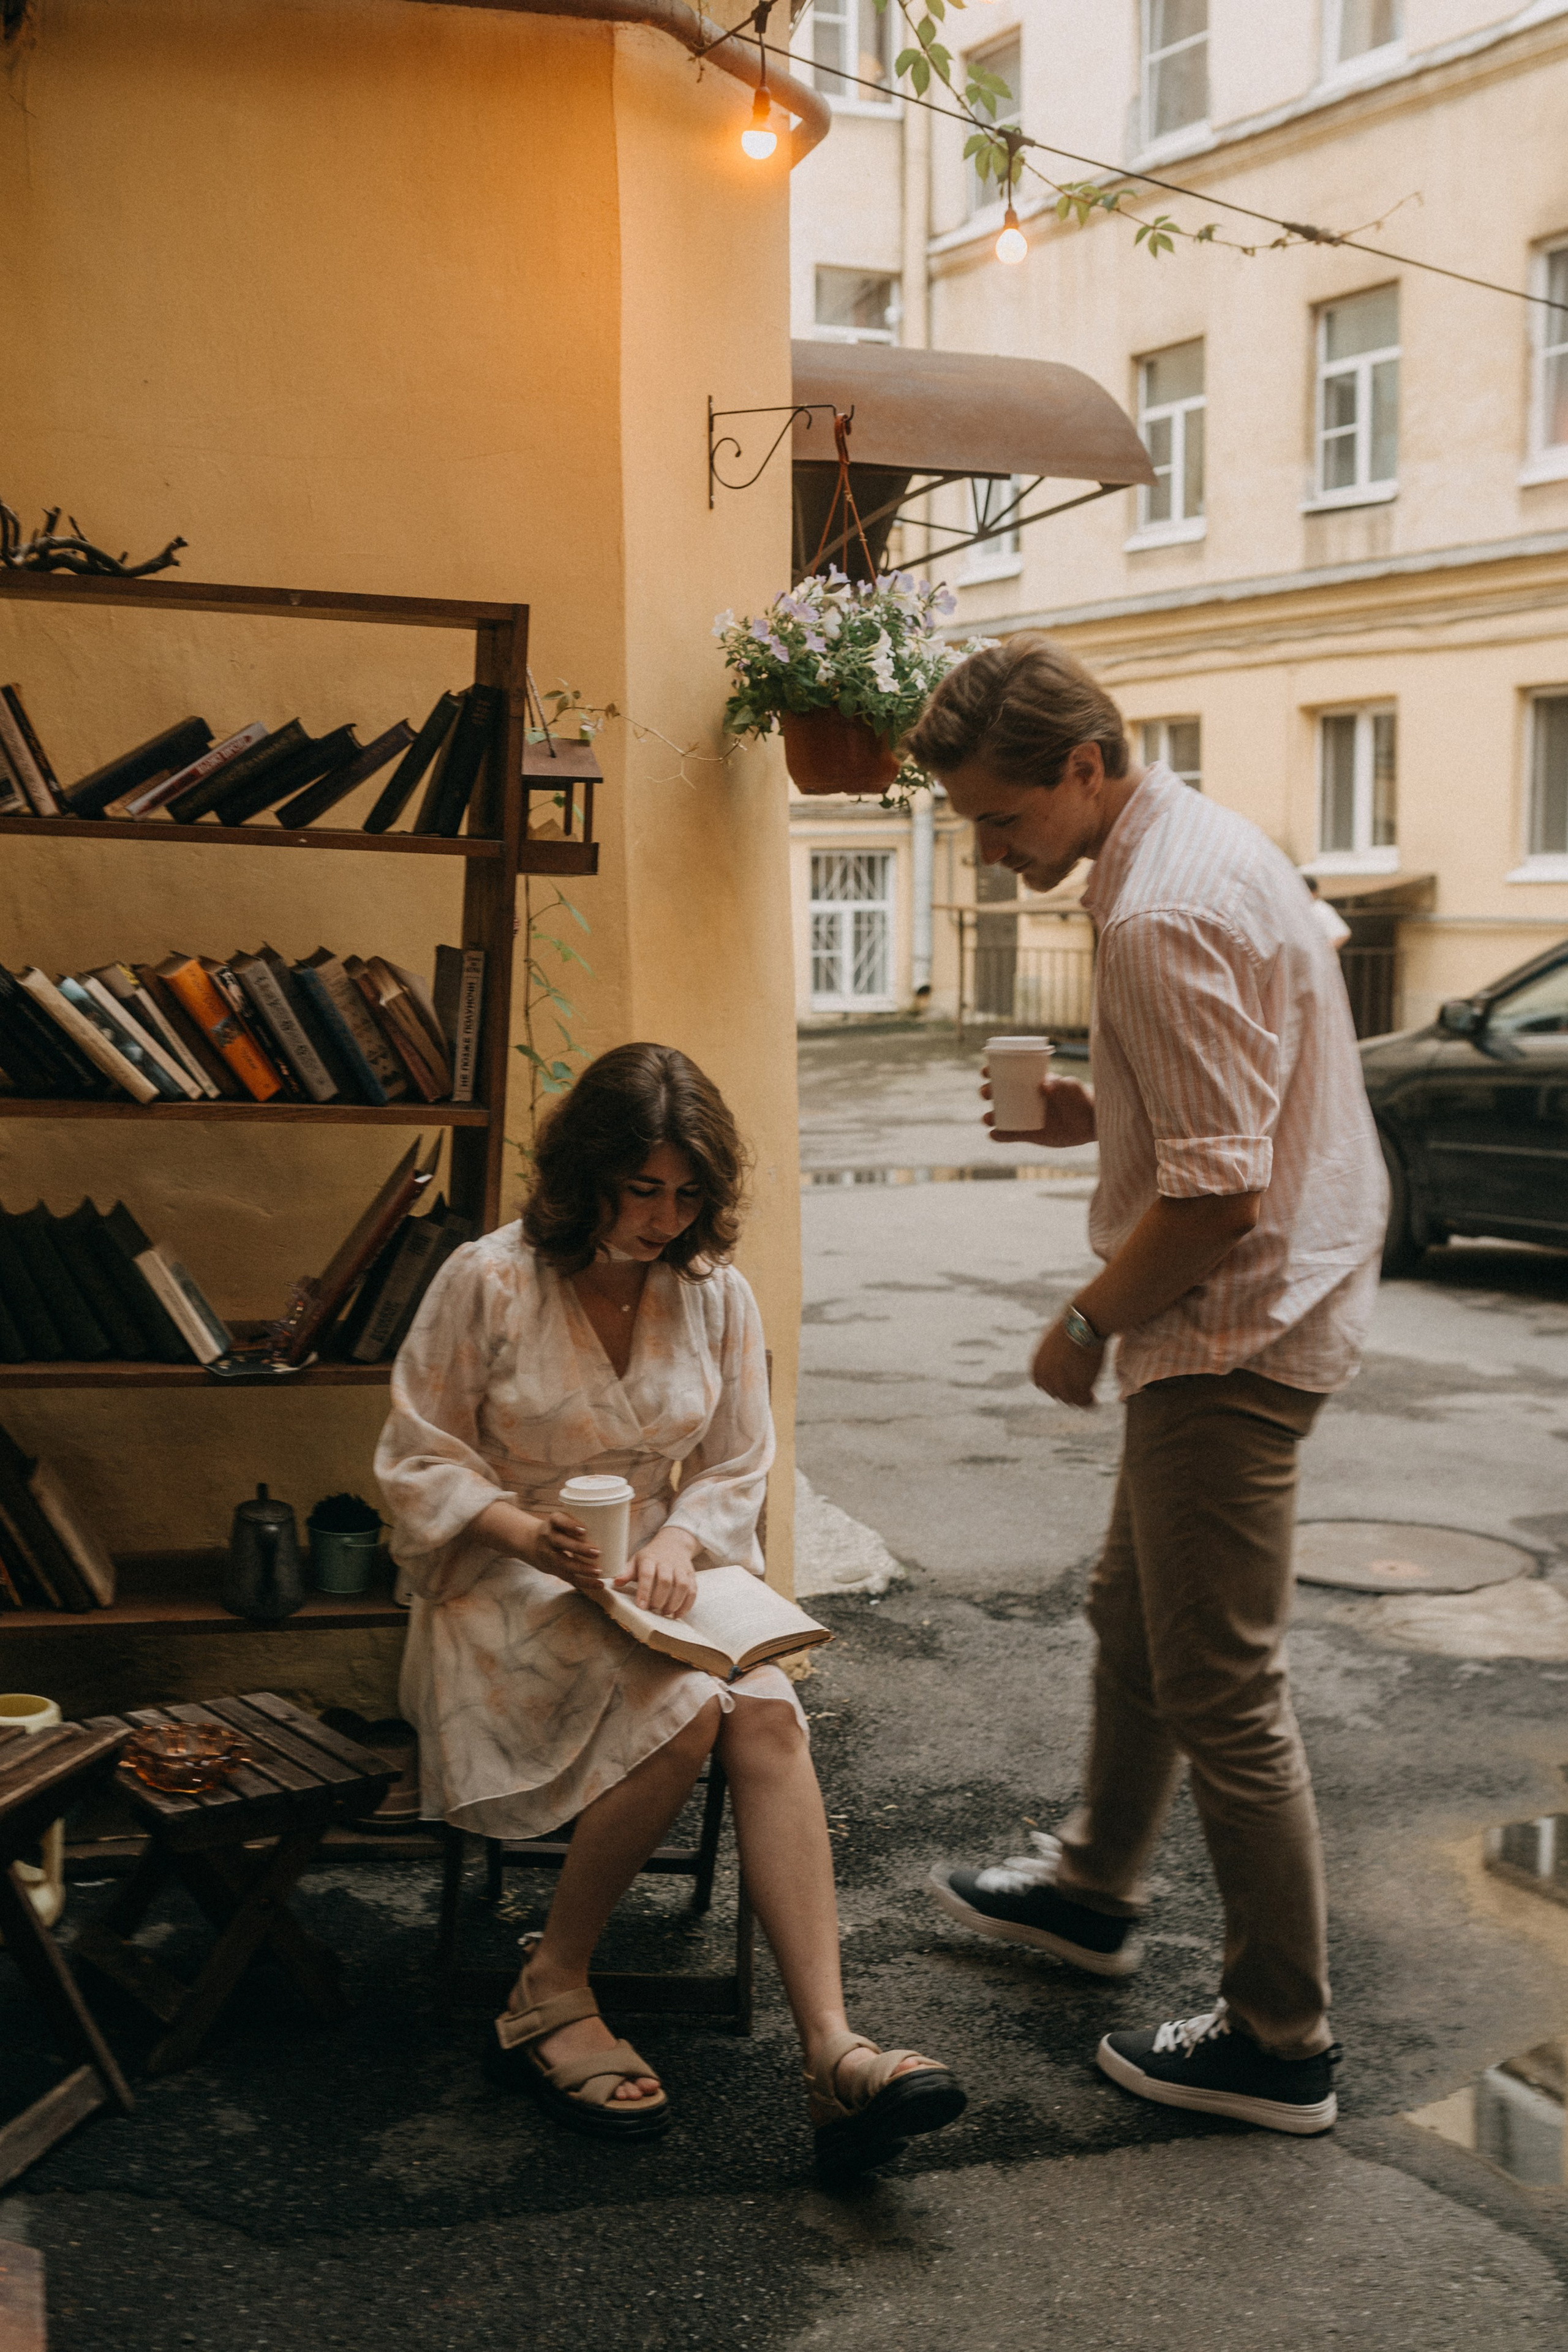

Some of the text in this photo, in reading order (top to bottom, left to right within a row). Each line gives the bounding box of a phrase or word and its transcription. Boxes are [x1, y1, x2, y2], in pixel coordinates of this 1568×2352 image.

[464, 982, 475, 1035] ПОЛУНОЧИ
[461, 1038, 471, 1071] ПОЗЖЕ
[461, 1074, 470, 1087] НЕ
